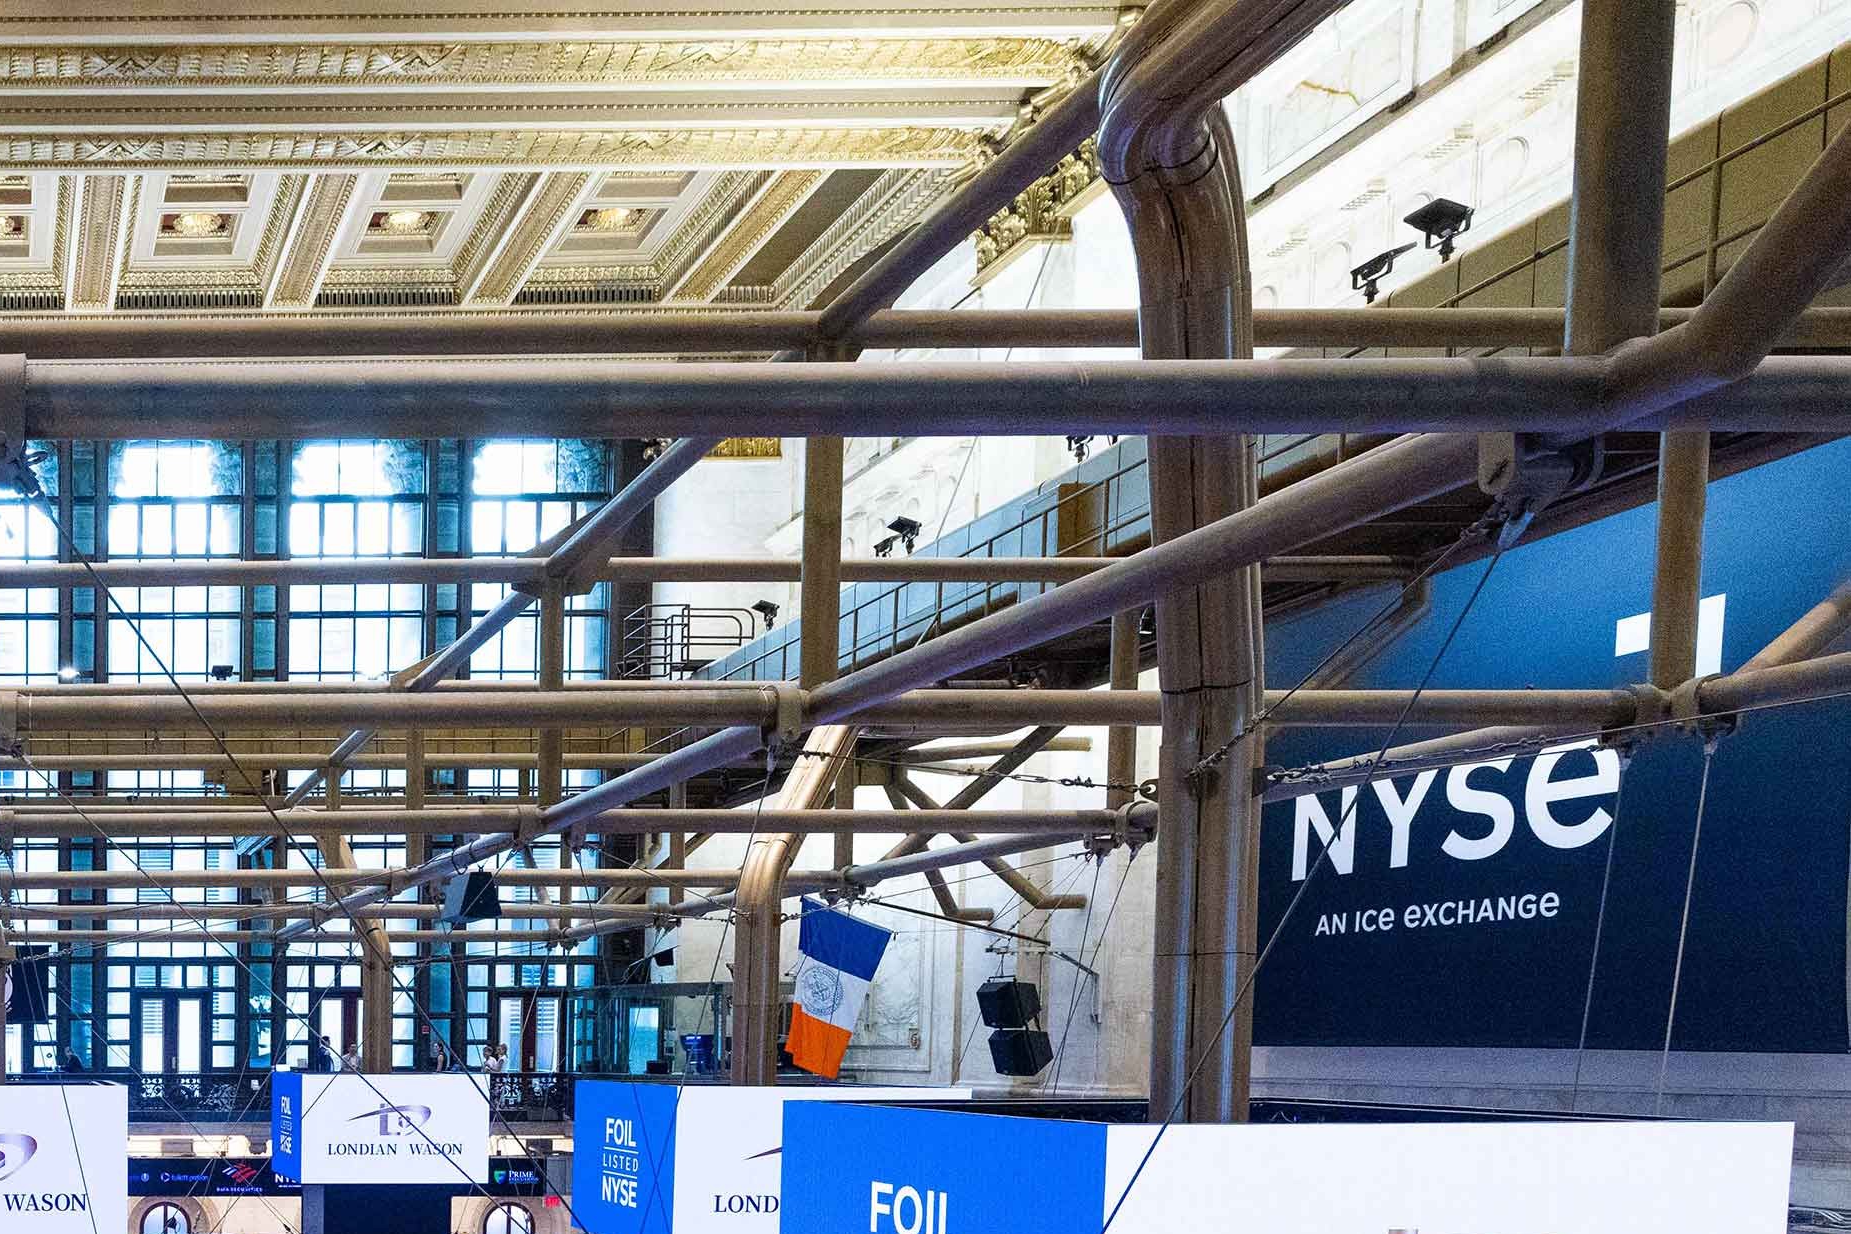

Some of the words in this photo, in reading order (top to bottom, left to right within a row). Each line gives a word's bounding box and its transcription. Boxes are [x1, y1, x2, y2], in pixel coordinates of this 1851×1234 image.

[1315, 912, 1347, 937] AN
[606, 1117, 636, 1147] FOIL
[328, 1143, 397, 1156] LONDIAN
[410, 1143, 463, 1155] WASON
[603, 1153, 638, 1172] LISTED
[602, 1175, 637, 1208] NYSE
[3, 1193, 87, 1212] WASON
[714, 1195, 779, 1213] LOND
